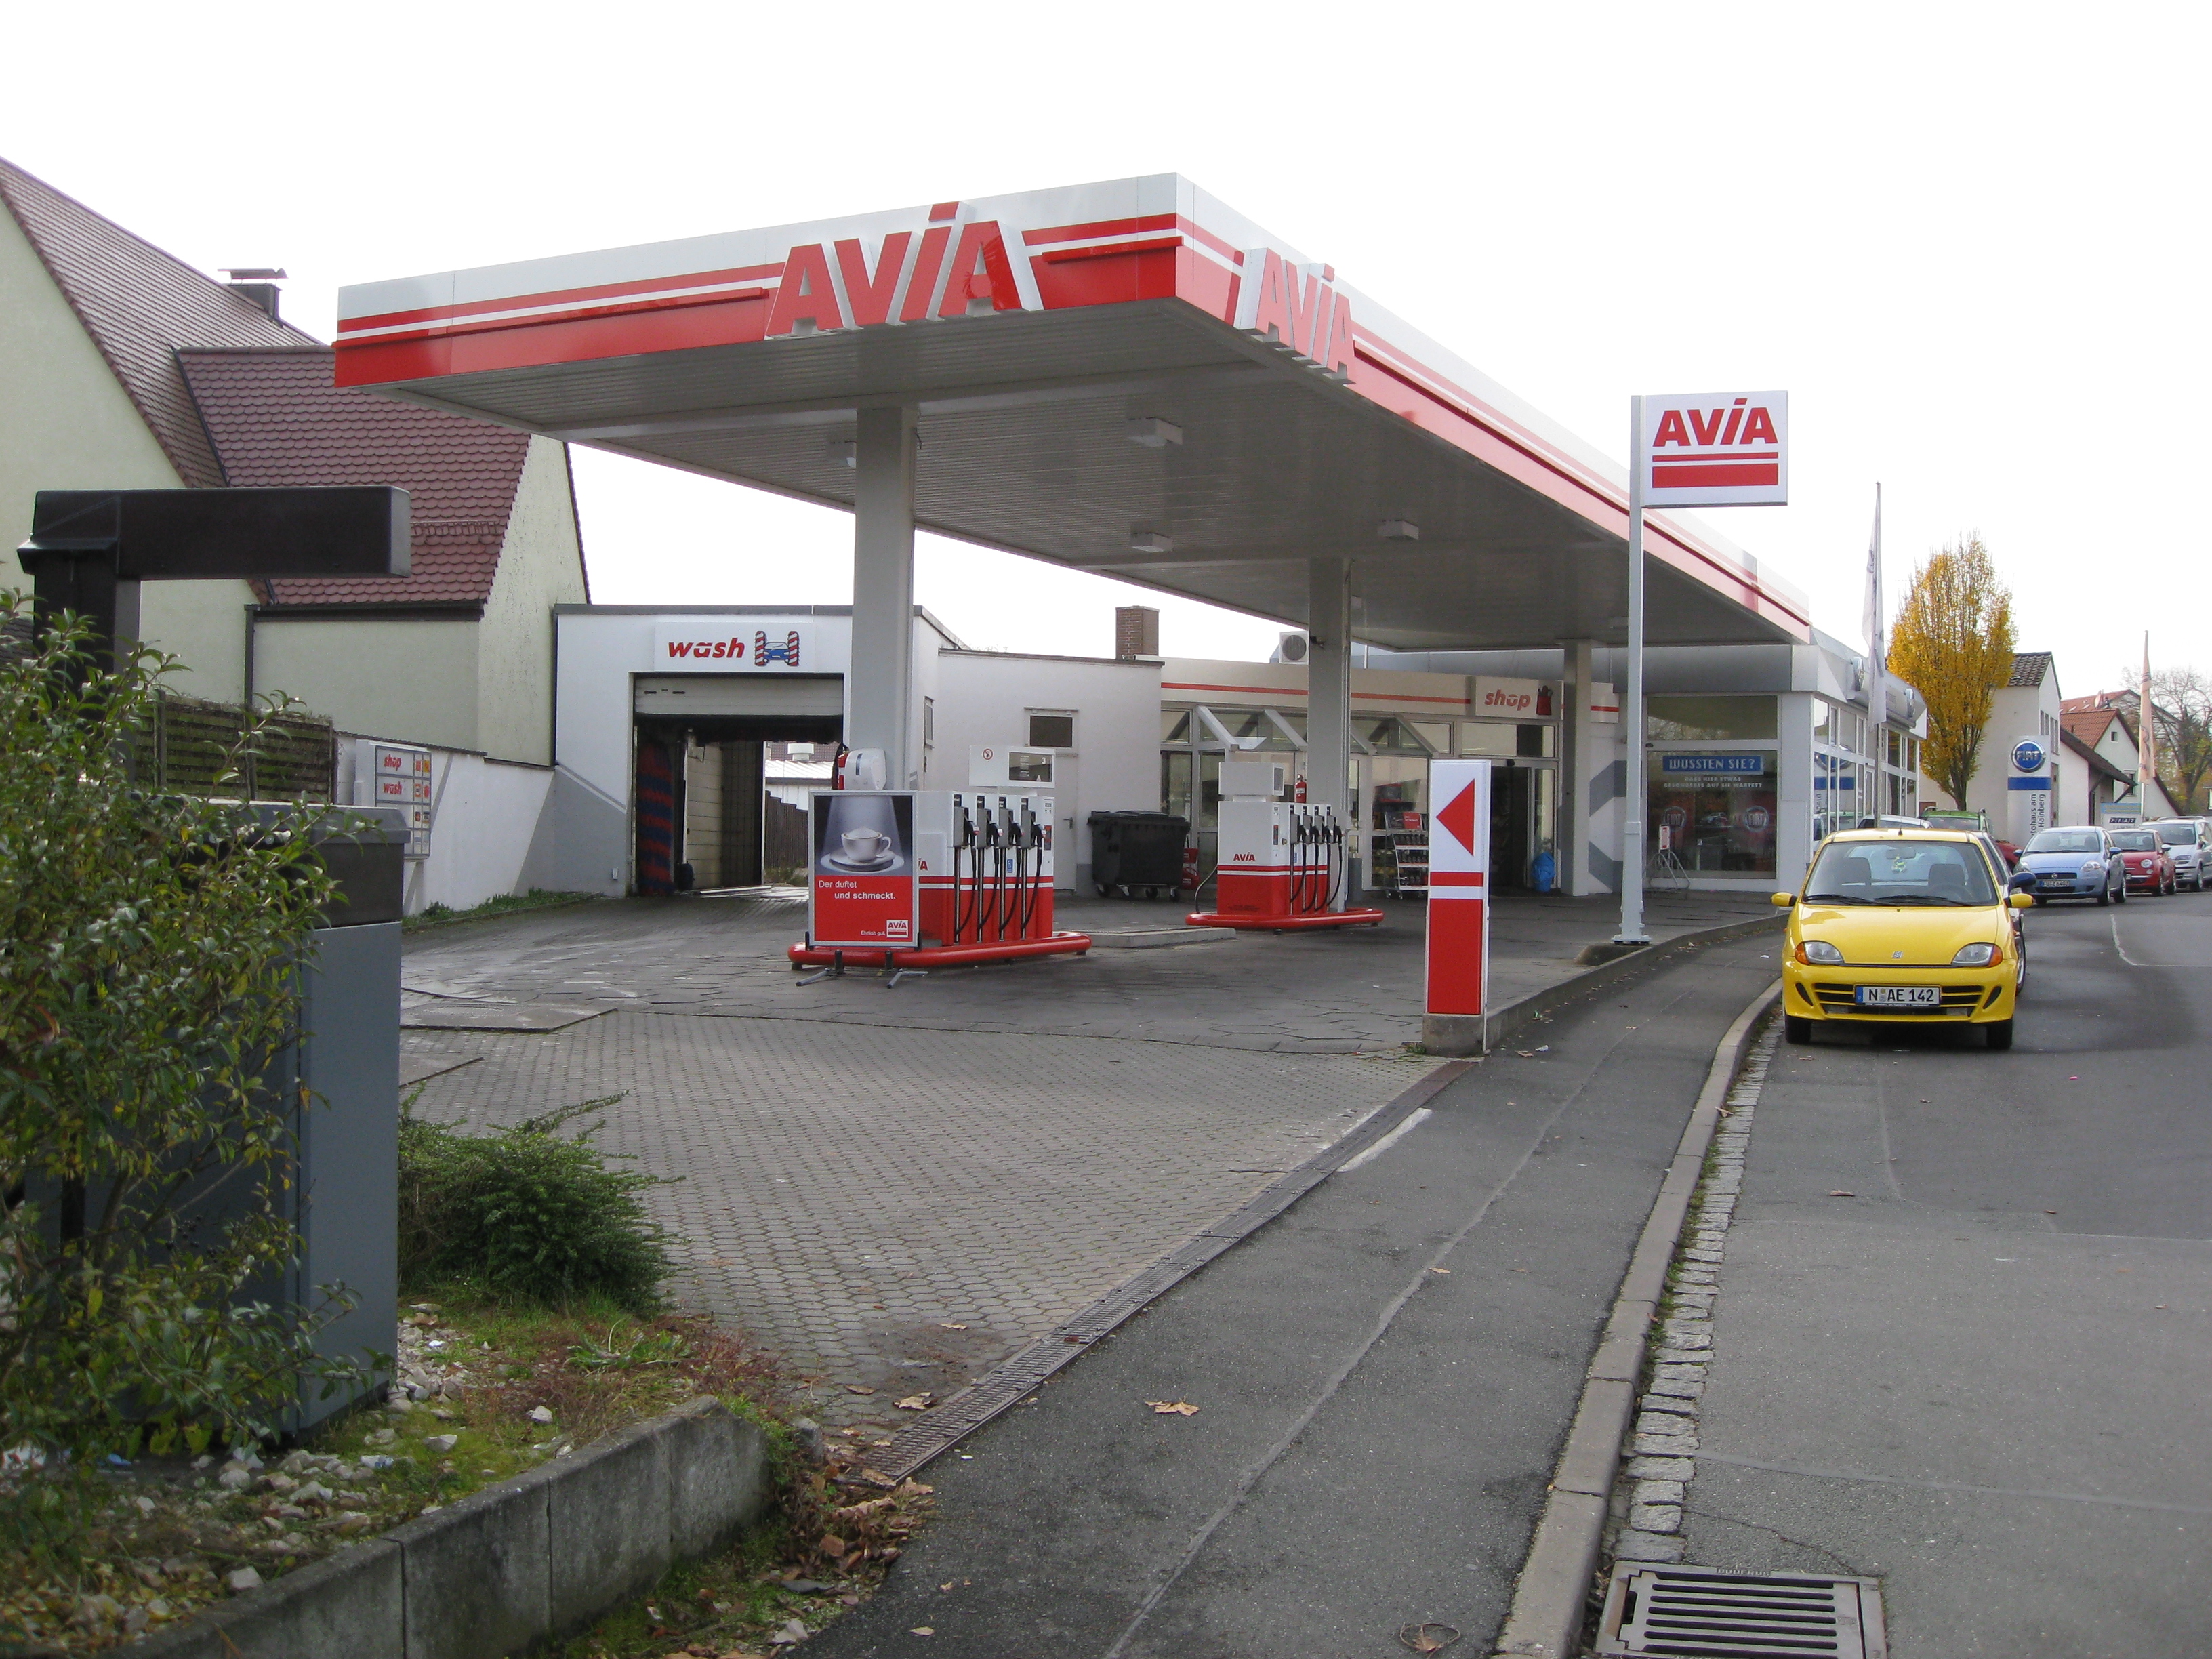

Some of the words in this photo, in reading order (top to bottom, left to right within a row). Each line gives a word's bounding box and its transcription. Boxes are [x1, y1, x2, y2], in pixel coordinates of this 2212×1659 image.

[668, 637, 745, 659] wash
[1484, 689, 1531, 711] shop
[1041, 756, 1047, 765] 3
[2016, 750, 2040, 761] FIAT
[384, 754, 402, 771] shop
[1669, 759, 1724, 769] WUSSTEN
[1729, 758, 1755, 769] SIE?
[2037, 794, 2047, 828] Hainberg
[835, 880, 857, 888] duftet
[834, 891, 851, 899] und
[853, 891, 896, 899] schmeckt.
[1909, 989, 1934, 1002] 142
